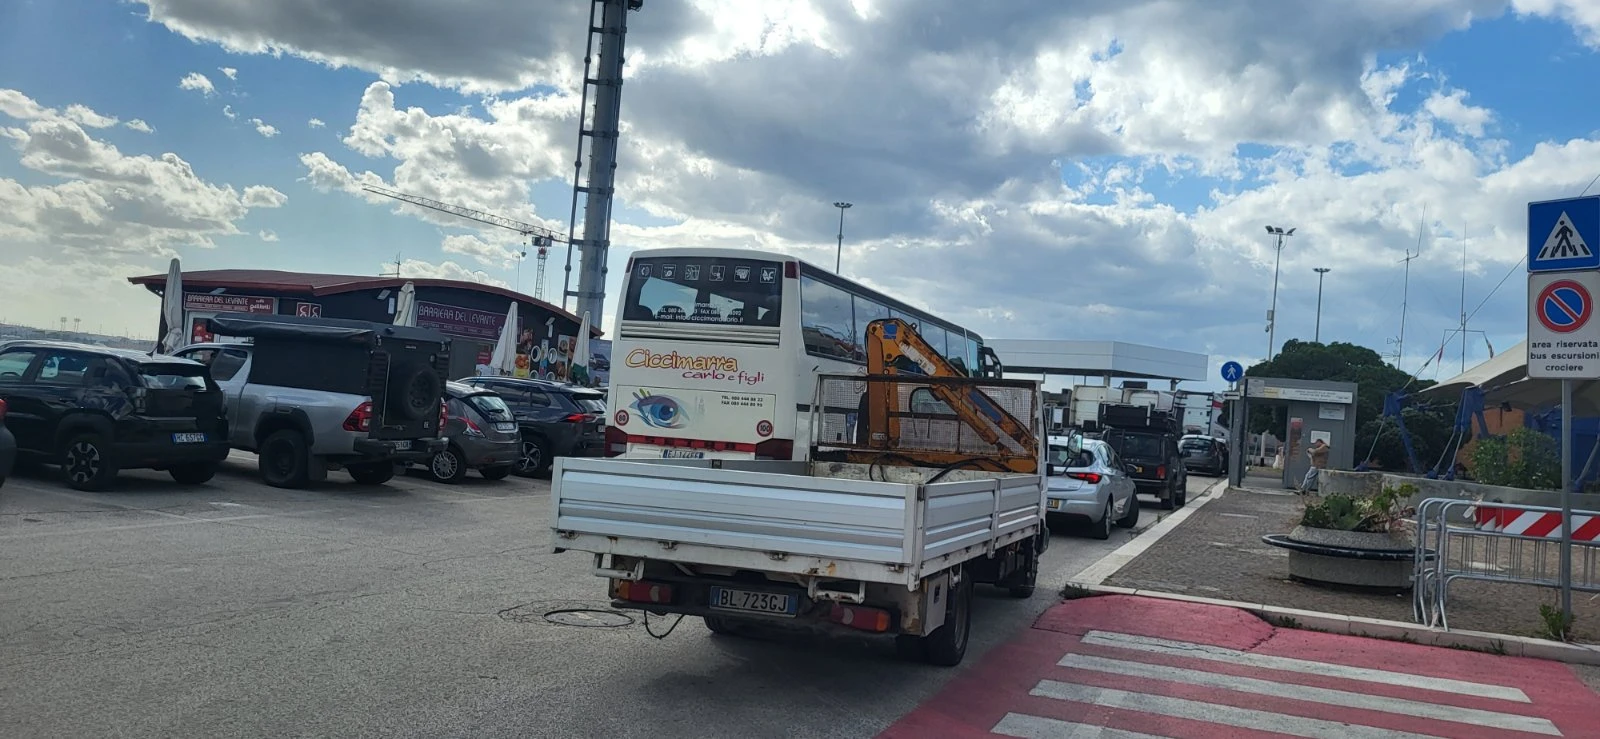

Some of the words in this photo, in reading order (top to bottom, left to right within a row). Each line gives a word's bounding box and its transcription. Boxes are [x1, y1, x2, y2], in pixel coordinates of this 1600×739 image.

[225, 296, 249, 305] LEVANTE
[418, 305, 454, 320] BARRIERA
[455, 311, 467, 322] DEL
[468, 313, 497, 326] LEVANTE
[1556, 340, 1599, 348] riservata
[625, 349, 738, 372] Ciccimarra
[1530, 352, 1547, 360] bus
[1550, 351, 1600, 360] escursioni
[682, 370, 725, 380] carlo
[738, 371, 765, 386] figli
[720, 590, 738, 607] BL
[742, 592, 787, 612] 723GJ
